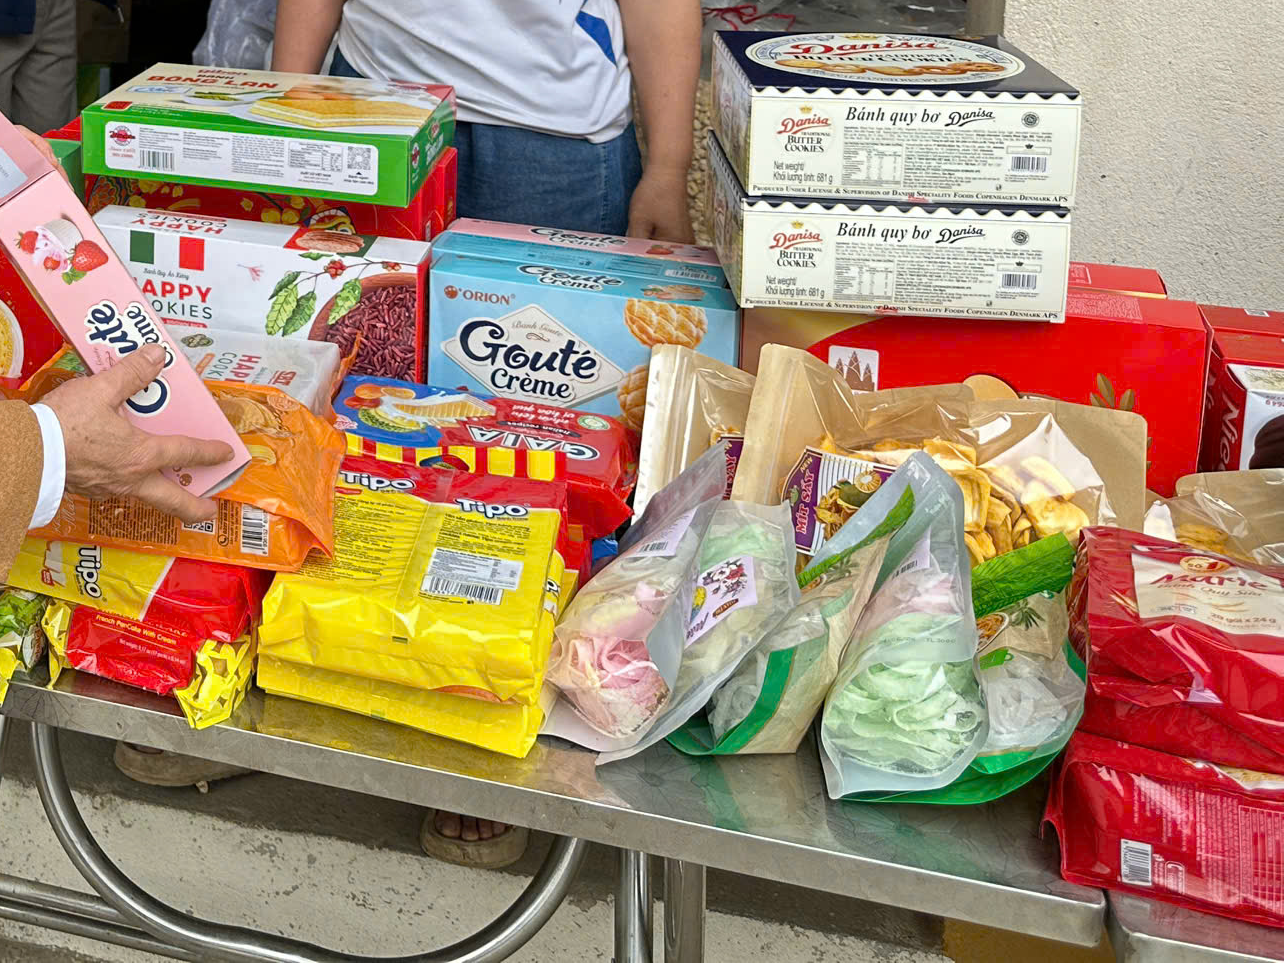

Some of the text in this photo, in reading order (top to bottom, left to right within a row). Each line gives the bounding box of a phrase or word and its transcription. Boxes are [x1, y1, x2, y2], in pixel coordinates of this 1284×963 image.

[784, 39, 939, 55] Danisa
[777, 114, 832, 135] Danisa
[846, 106, 884, 122] Bánh
[890, 111, 917, 126] quy
[944, 108, 996, 127] Danisa
[784, 143, 825, 153] COOKIES
[787, 135, 823, 145] BUTTER
[773, 160, 784, 170] Net
[816, 174, 827, 183] 681
[1052, 195, 1068, 203] APS
[129, 217, 224, 235] HAPPY
[137, 212, 228, 228] COOKIES
[768, 229, 824, 250] Danisa
[836, 222, 875, 237] Bánh
[880, 227, 908, 242] quy
[935, 225, 986, 244] Danisa
[779, 250, 815, 260] BUTTER
[776, 259, 817, 268] COOKIES
[766, 275, 776, 285] Net
[136, 277, 213, 304] APPY
[462, 289, 512, 306] ORION
[808, 288, 821, 297] 681
[151, 299, 213, 320] OKIES
[1042, 311, 1058, 319] APS
[459, 320, 597, 380] Gouté
[490, 367, 572, 399] Crème
[1149, 573, 1268, 591] Marie
